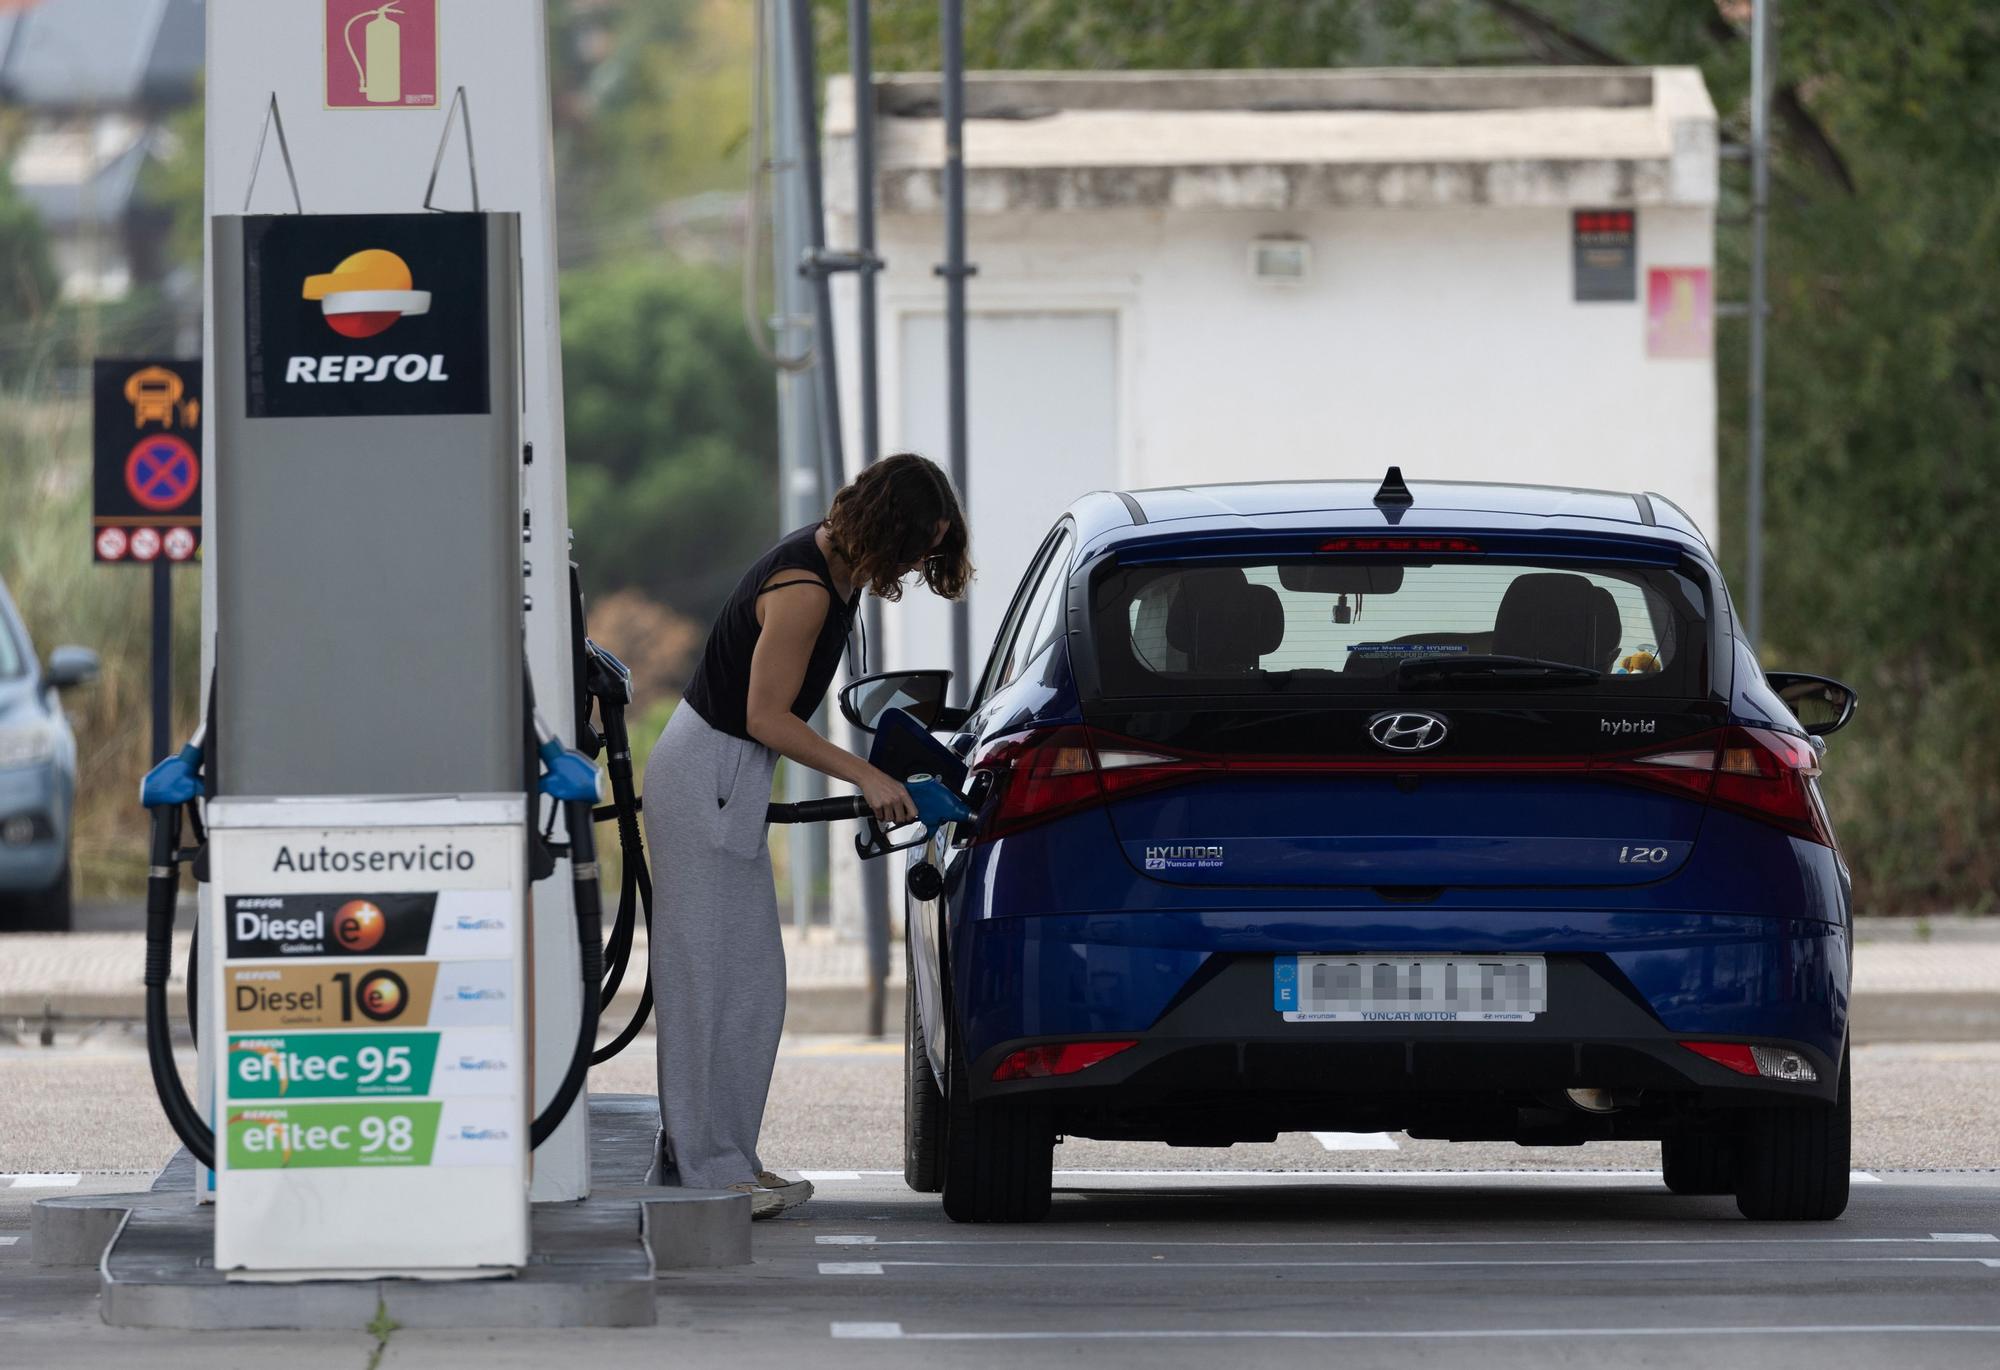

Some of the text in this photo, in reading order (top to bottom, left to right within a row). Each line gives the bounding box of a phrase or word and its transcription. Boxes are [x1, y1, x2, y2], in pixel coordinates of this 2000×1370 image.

[285, 353, 449, 383] REPSOL
[1601, 718, 1655, 735] hybrid
[273, 844, 474, 872] Autoservicio
[1146, 846, 1223, 858] HYUNDAI
[1166, 860, 1223, 868] Yuncar Motor
[236, 911, 324, 940] Diesel
[236, 969, 410, 1022] Diesel 10
[1281, 988, 1291, 1000] E
[1361, 1011, 1457, 1020] YUNCAR MOTOR
[239, 1046, 412, 1083] efitec 95
[242, 1115, 413, 1152] efitec 98
